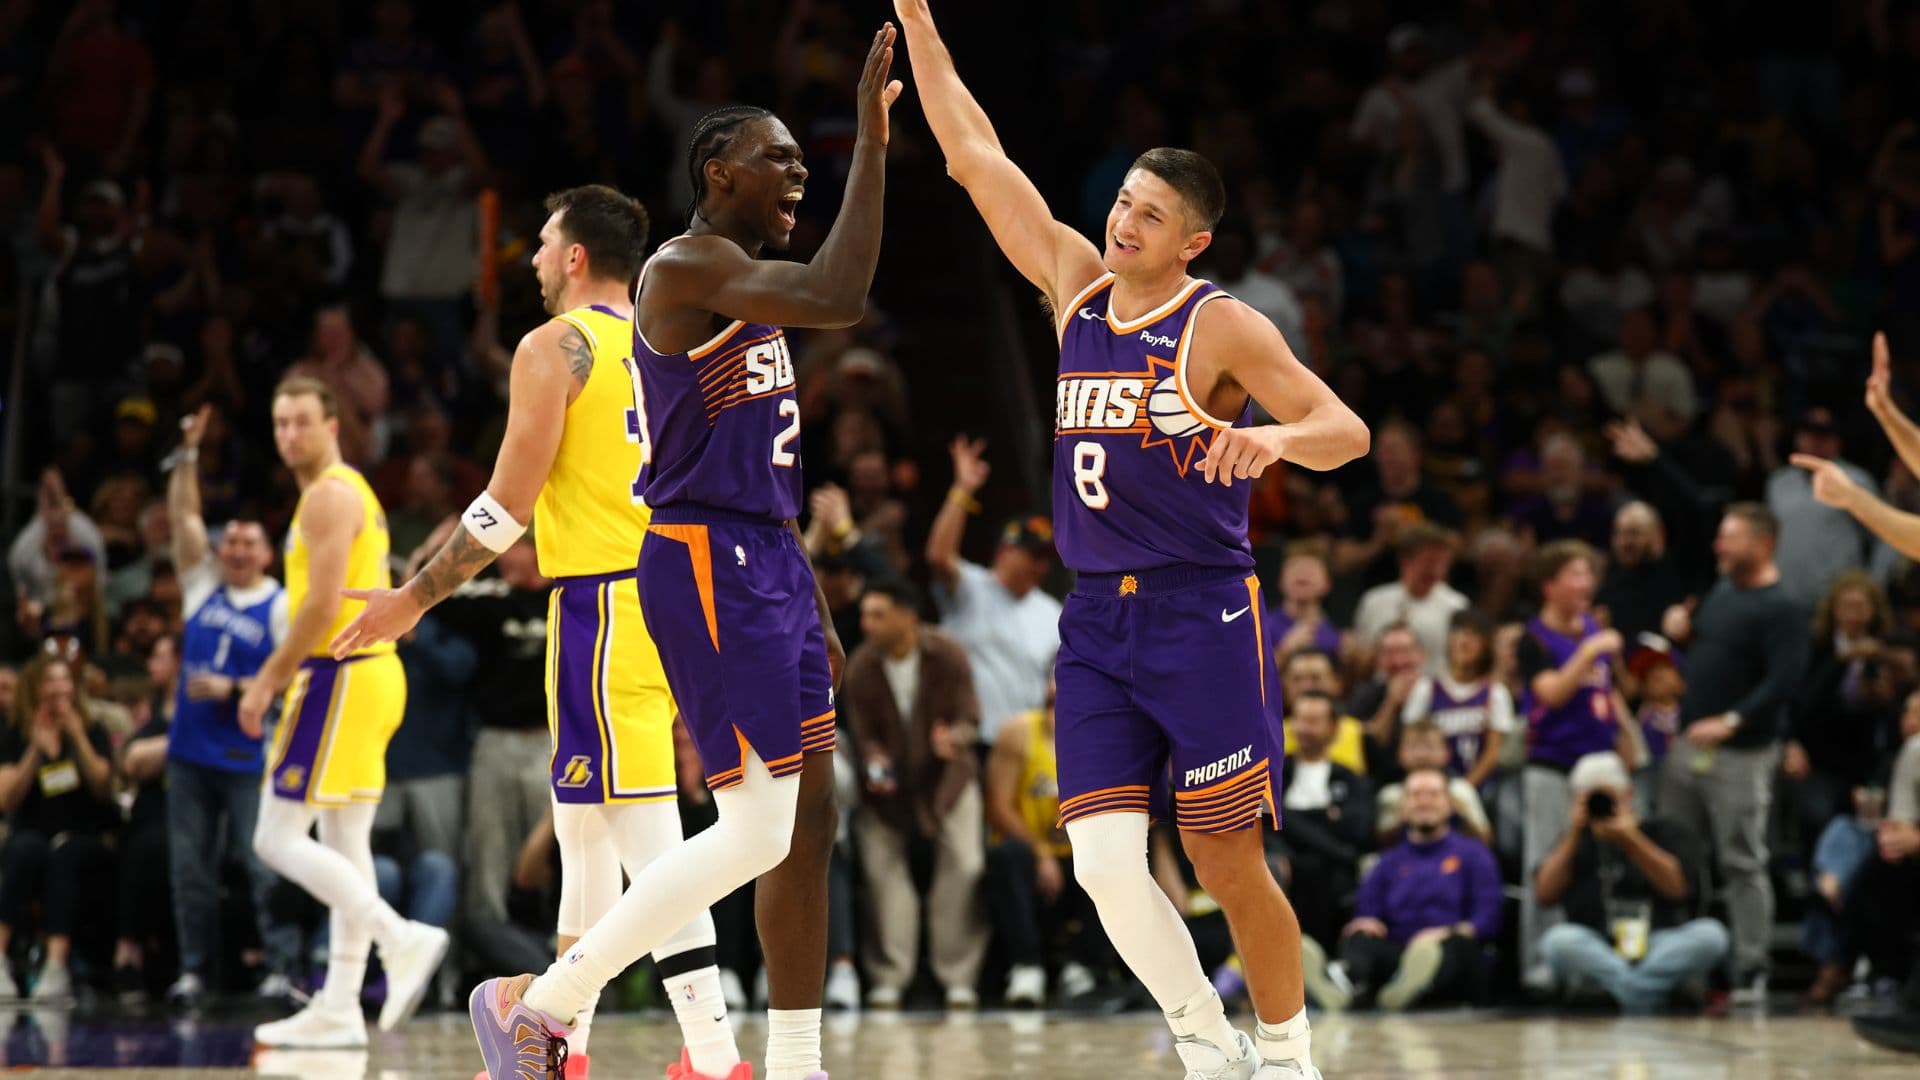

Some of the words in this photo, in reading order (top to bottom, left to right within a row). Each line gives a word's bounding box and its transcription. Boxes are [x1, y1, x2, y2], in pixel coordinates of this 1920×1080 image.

[1140, 330, 1178, 348] PayPal
[745, 336, 796, 394] SU
[1056, 379, 1146, 429] UNS
[771, 398, 802, 468] 2
[1074, 441, 1111, 511] 8
[472, 507, 499, 530] 77
[1185, 744, 1253, 788] PHOENIX
